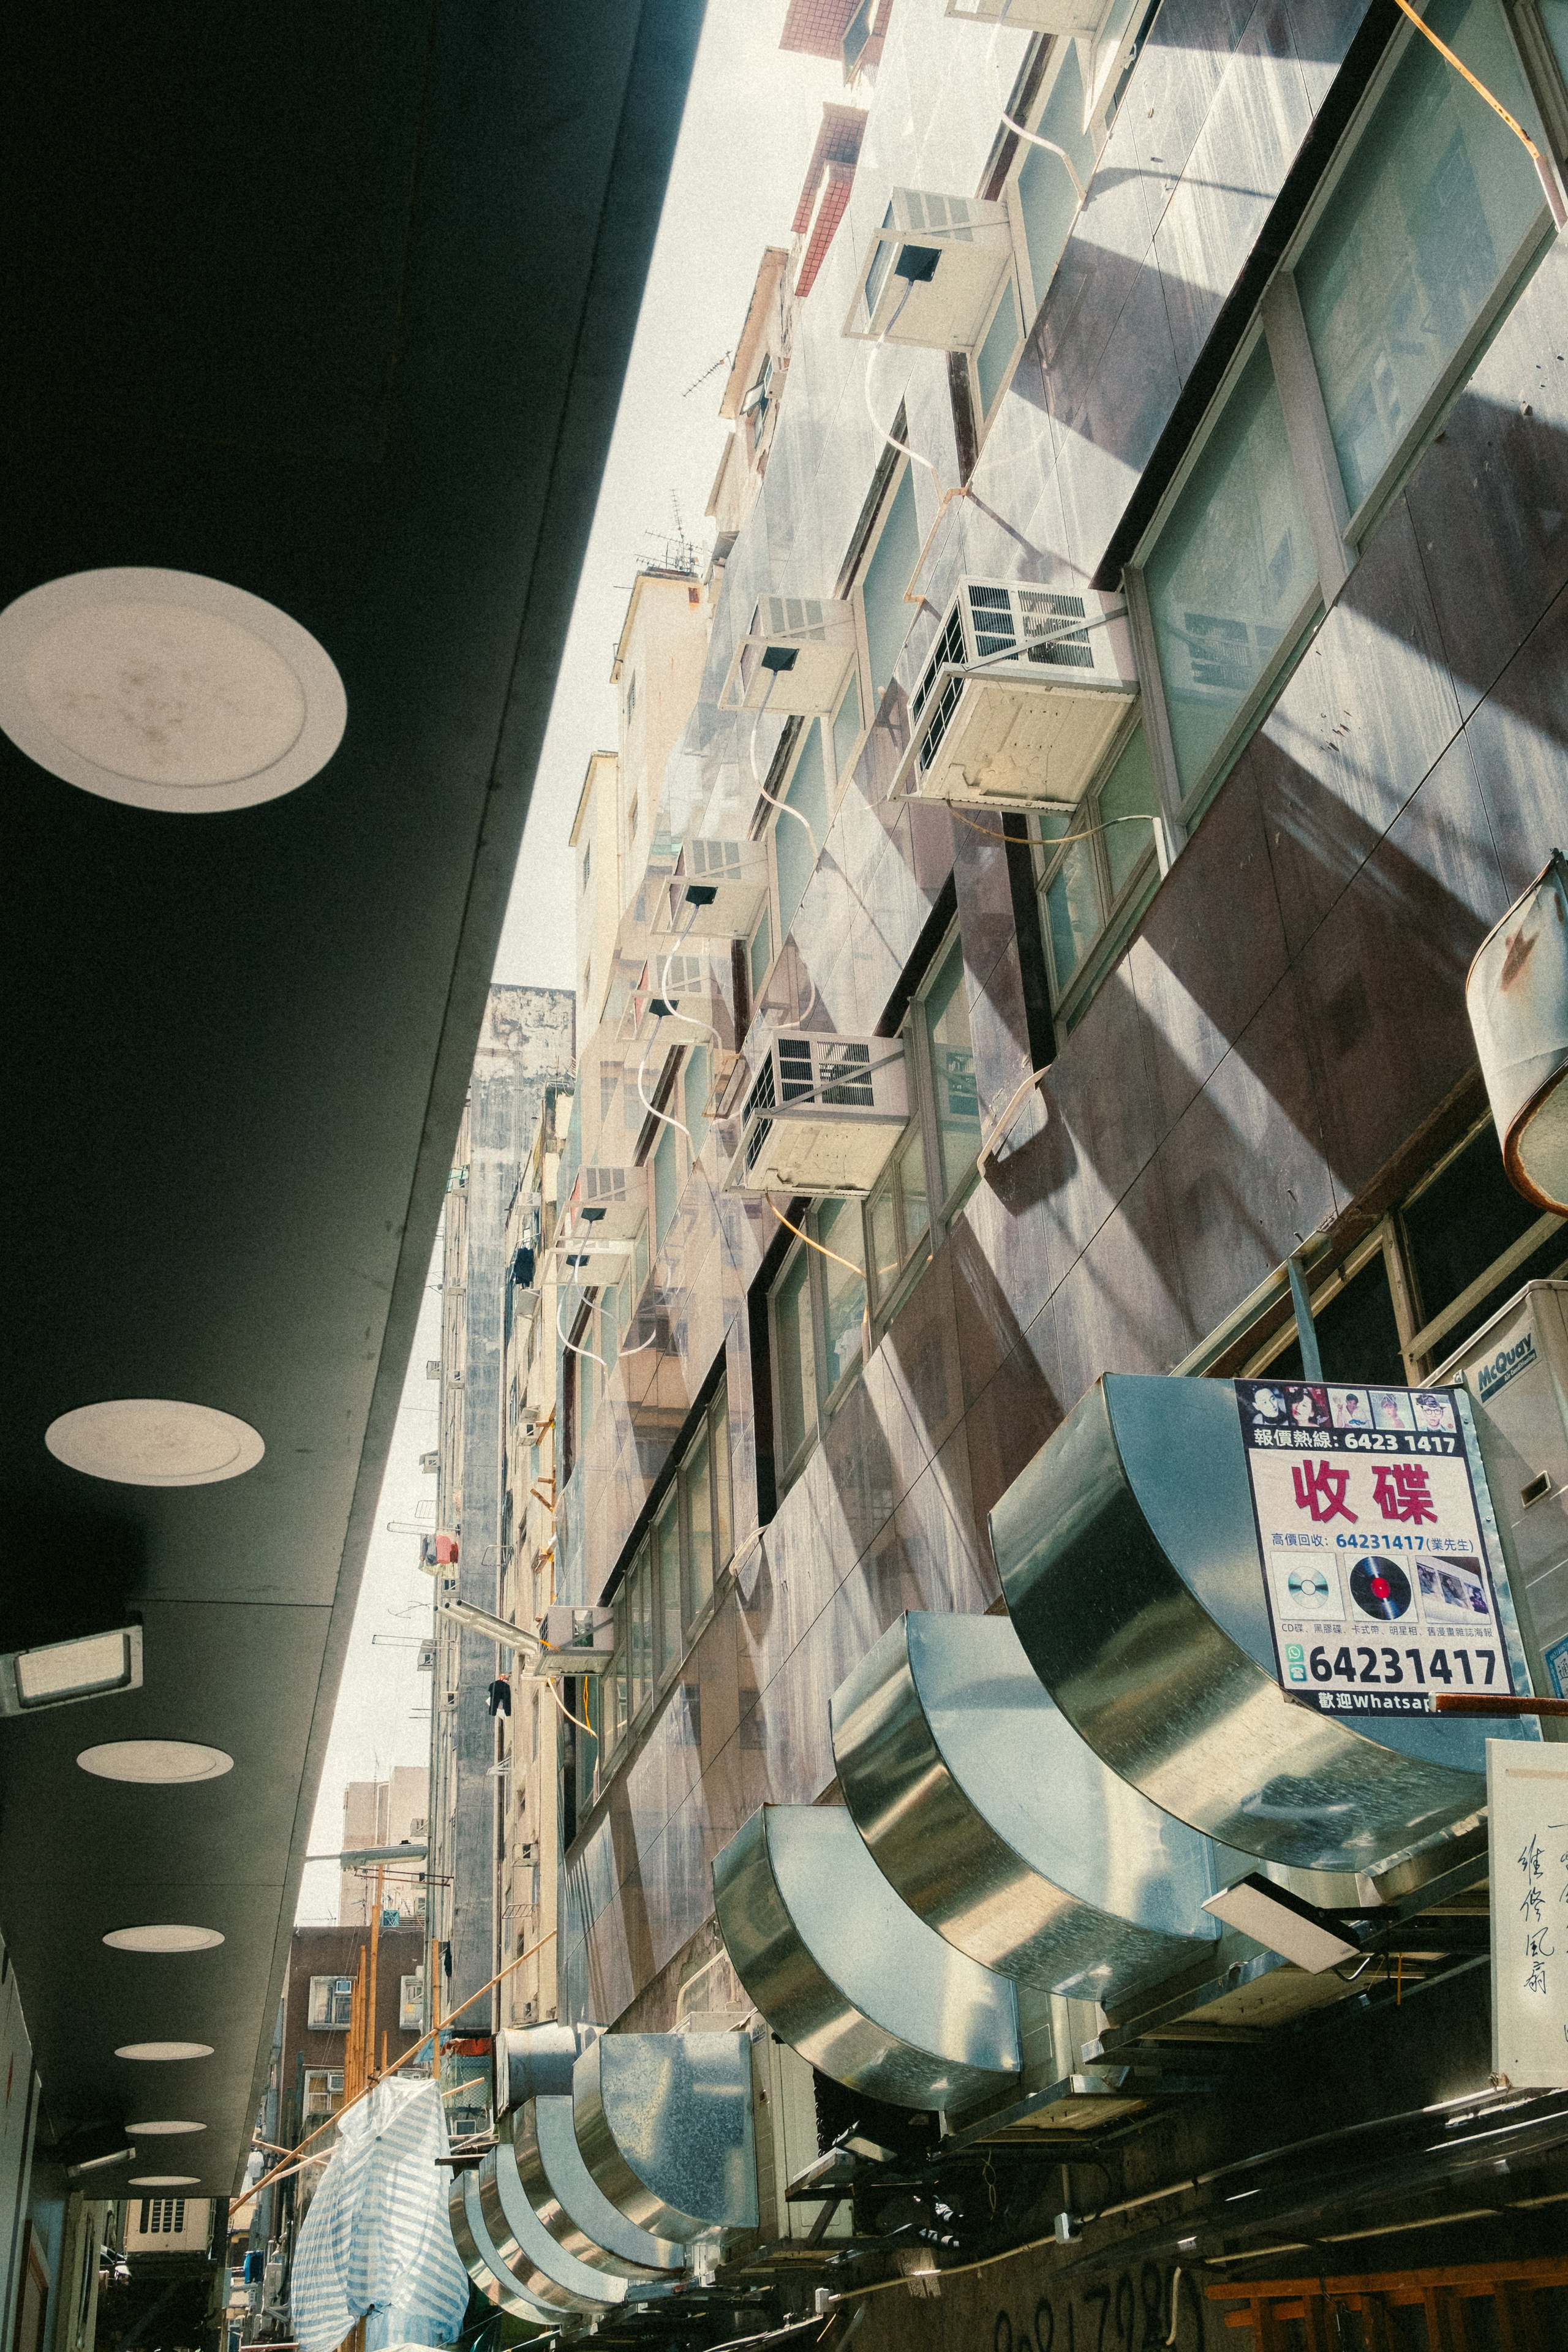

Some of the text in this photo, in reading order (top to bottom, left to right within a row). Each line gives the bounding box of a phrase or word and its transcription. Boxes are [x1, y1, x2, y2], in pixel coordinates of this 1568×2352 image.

[1478, 1333, 1531, 1392] McQuay
[1345, 1433, 1398, 1450] 6423
[1405, 1436, 1455, 1453] 1417
[1292, 1460, 1438, 1525] 收碟
[1310, 1646, 1496, 1684] 64231417
